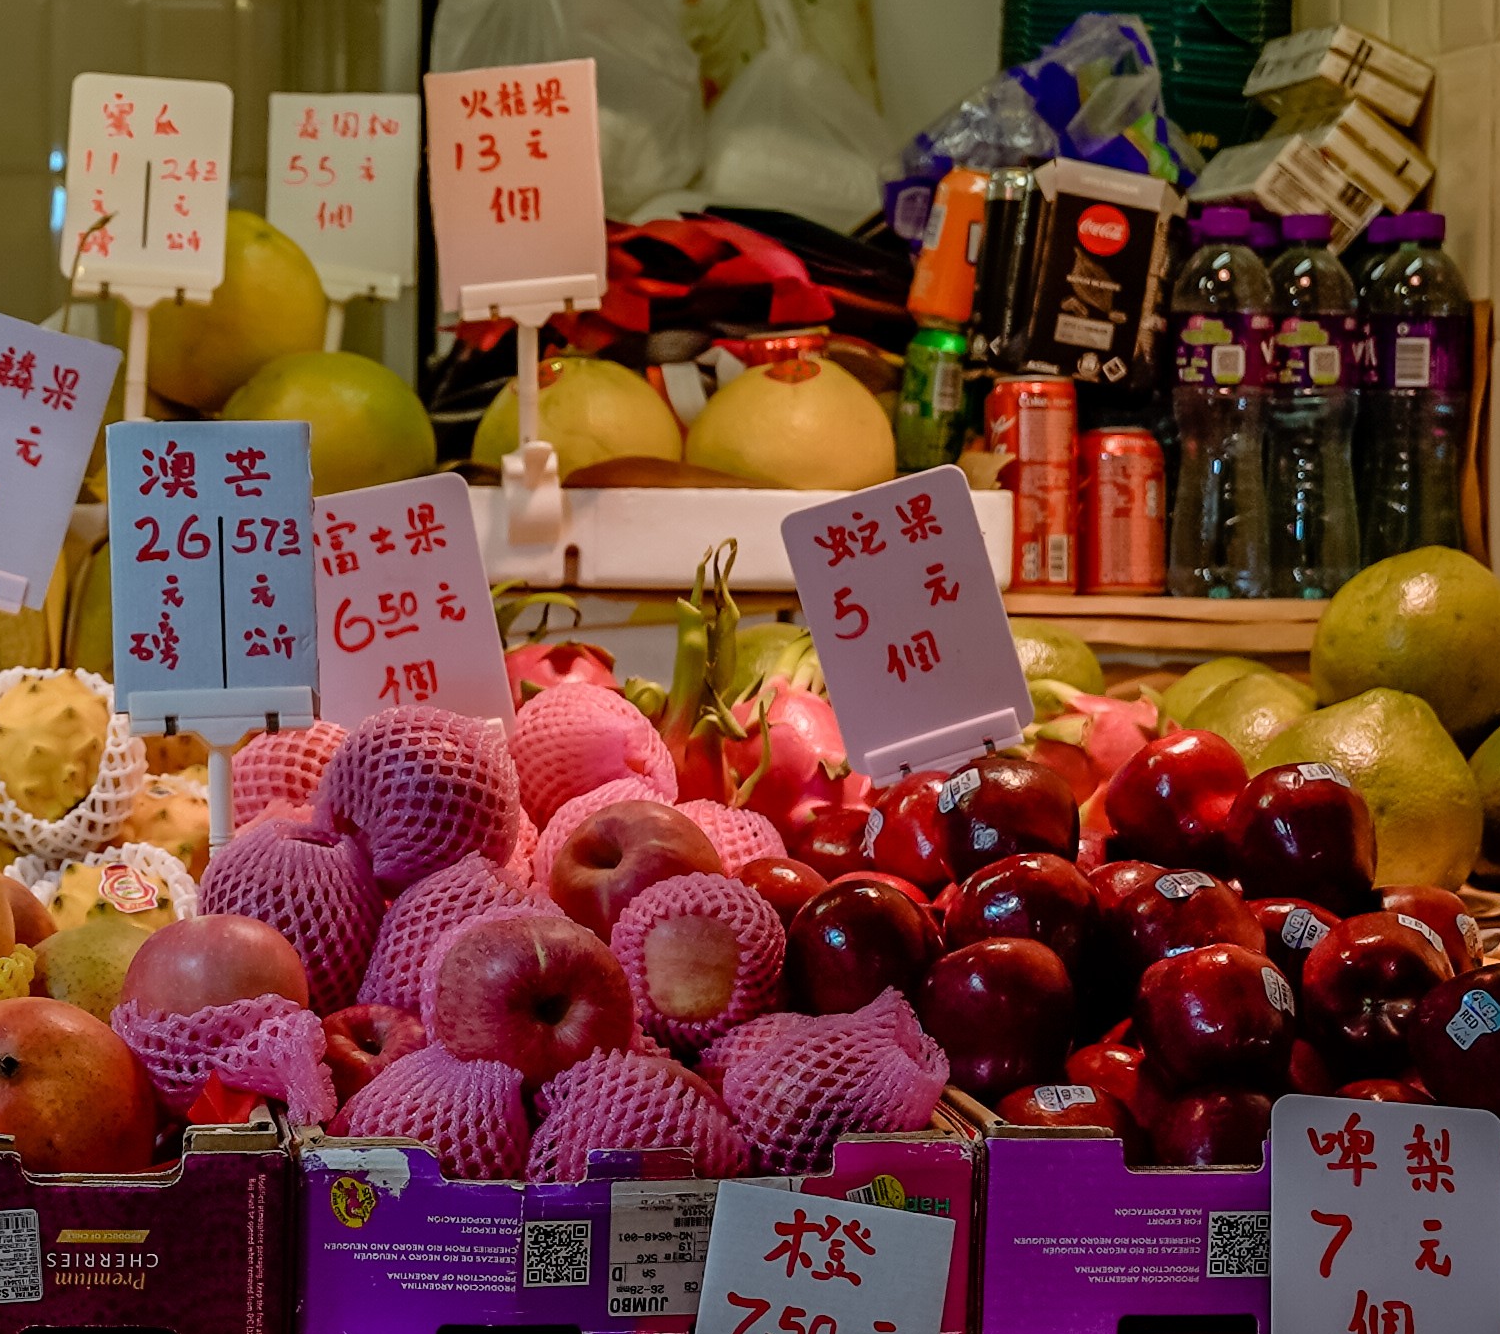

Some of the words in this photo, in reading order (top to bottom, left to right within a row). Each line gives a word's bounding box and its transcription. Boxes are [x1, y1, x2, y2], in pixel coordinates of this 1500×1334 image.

[460, 77, 570, 119] 火龍果
[85, 149, 120, 174] 11
[455, 133, 502, 173] 13
[526, 128, 549, 160] 元
[15, 426, 42, 468] 元
[139, 440, 271, 499] 澳芒
[135, 514, 212, 563] 26
[313, 502, 447, 576] 富士果
[814, 493, 945, 574] 蛇果
[435, 582, 467, 622] 元
[834, 586, 870, 640] 5
[924, 562, 960, 607] 元
[887, 630, 941, 683] 個
[1307, 1113, 1455, 1193] 啤梨
[45, 1252, 159, 1268] CHERRIES
[764, 1209, 875, 1286] 橙
[1310, 1210, 1353, 1278] 7
[1415, 1219, 1452, 1276] 元
[54, 1272, 146, 1291] Premium
[609, 1296, 669, 1314] JUMBO
